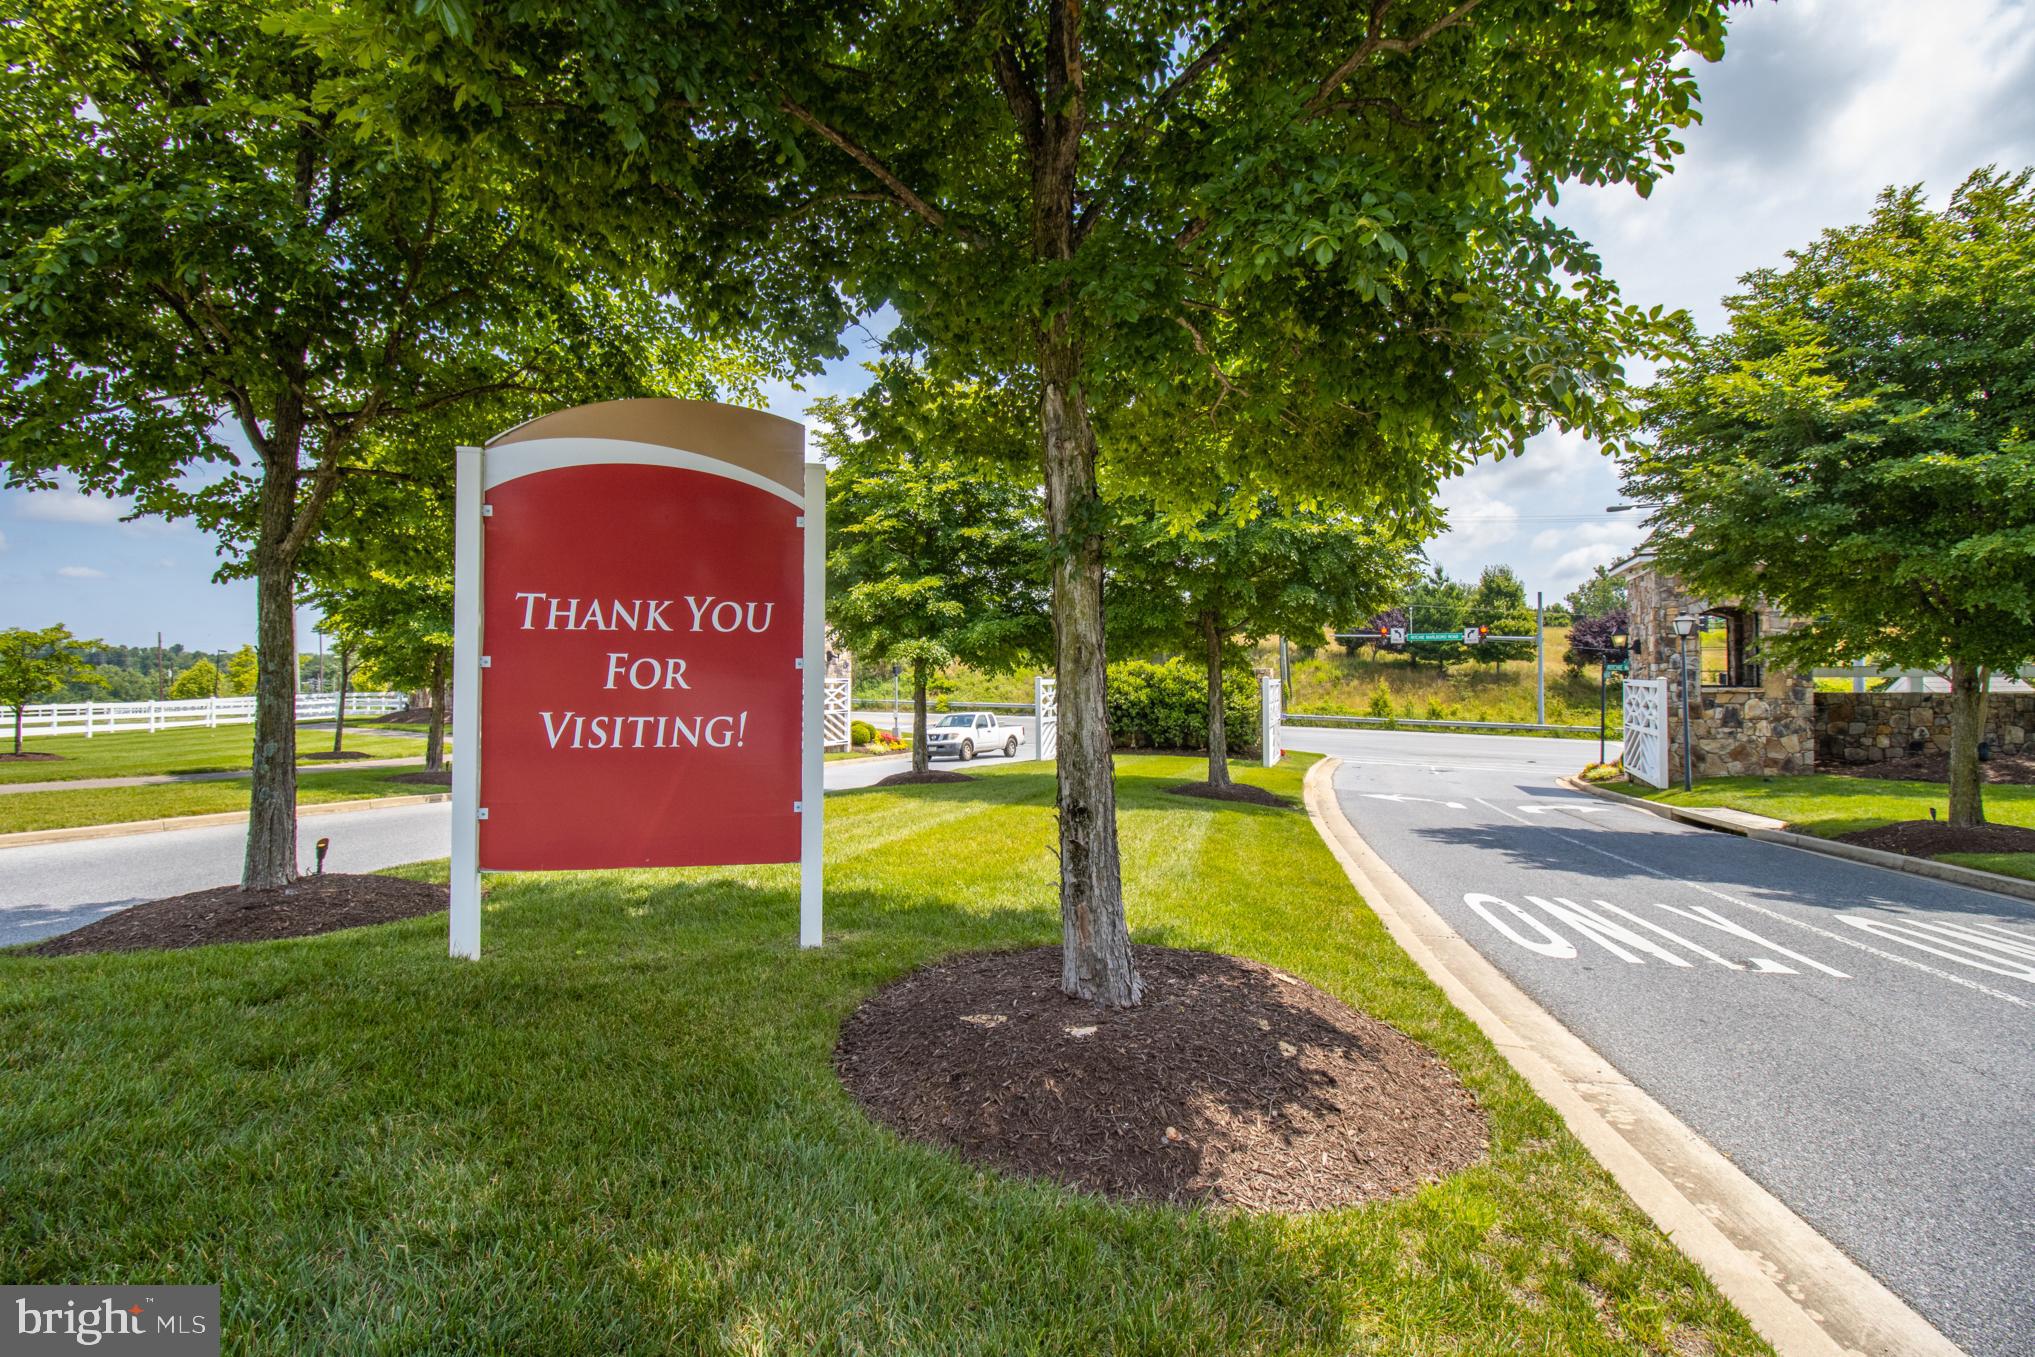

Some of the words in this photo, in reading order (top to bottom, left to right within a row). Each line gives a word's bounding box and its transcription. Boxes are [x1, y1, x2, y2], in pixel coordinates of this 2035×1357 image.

[515, 592, 674, 632] THANK
[683, 596, 775, 633] YOU
[603, 653, 692, 690] FOR
[538, 711, 748, 749] VISITING!
[1463, 892, 1854, 979] ONLY
